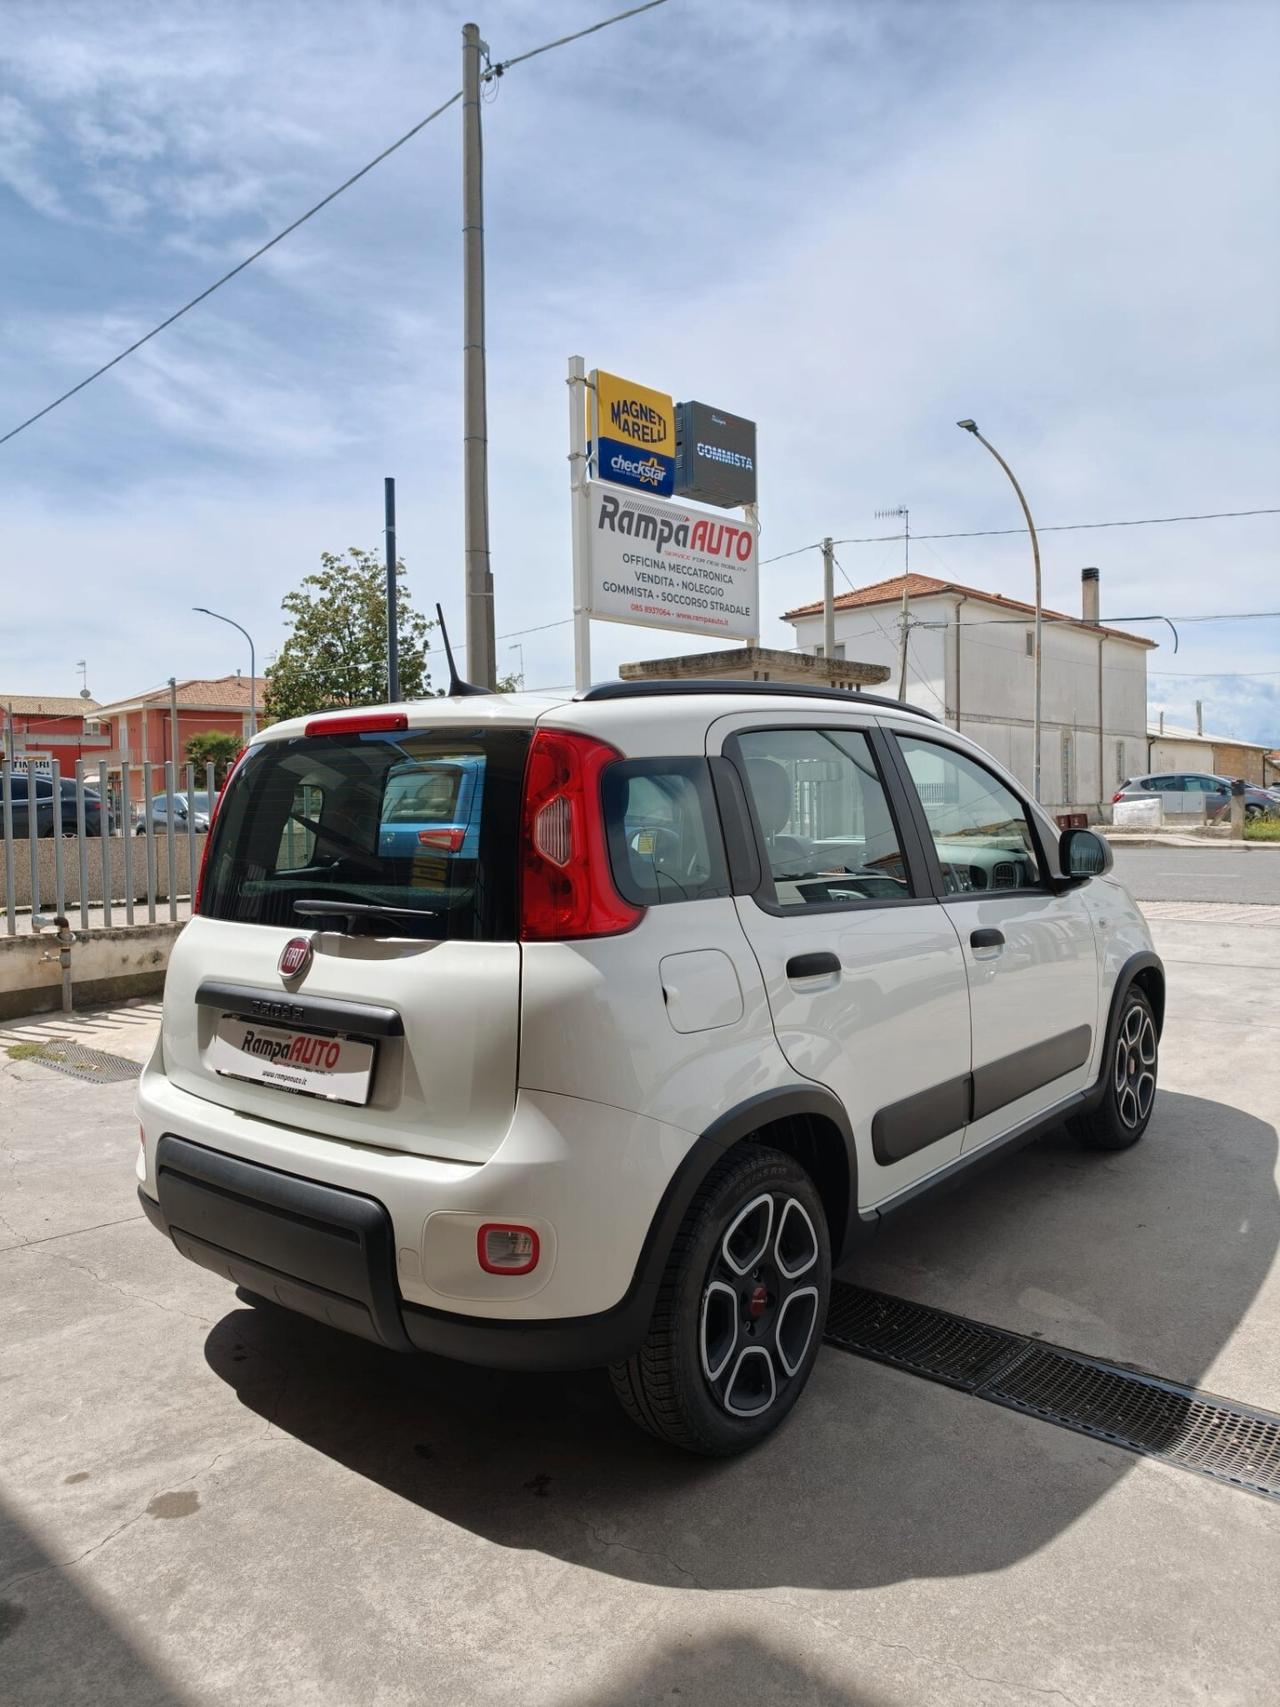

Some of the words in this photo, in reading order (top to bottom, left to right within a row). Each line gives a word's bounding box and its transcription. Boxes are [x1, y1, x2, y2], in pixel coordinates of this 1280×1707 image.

[611, 400, 667, 431] MAGNETI
[611, 414, 667, 443] MARELLI
[611, 455, 667, 481] checkstar
[697, 442, 753, 470] GOMMISTA
[622, 552, 666, 571] OFFICINA
[668, 564, 734, 585] MECCATRONICA
[634, 571, 675, 587] VENDITA
[681, 580, 724, 598] NOLEGGIO
[602, 581, 653, 600] GOMMISTA
[661, 592, 708, 609] SOCCORSO
[710, 600, 751, 617] STRADALE
[630, 603, 643, 613] 085
[285, 948, 305, 968] FIAT
